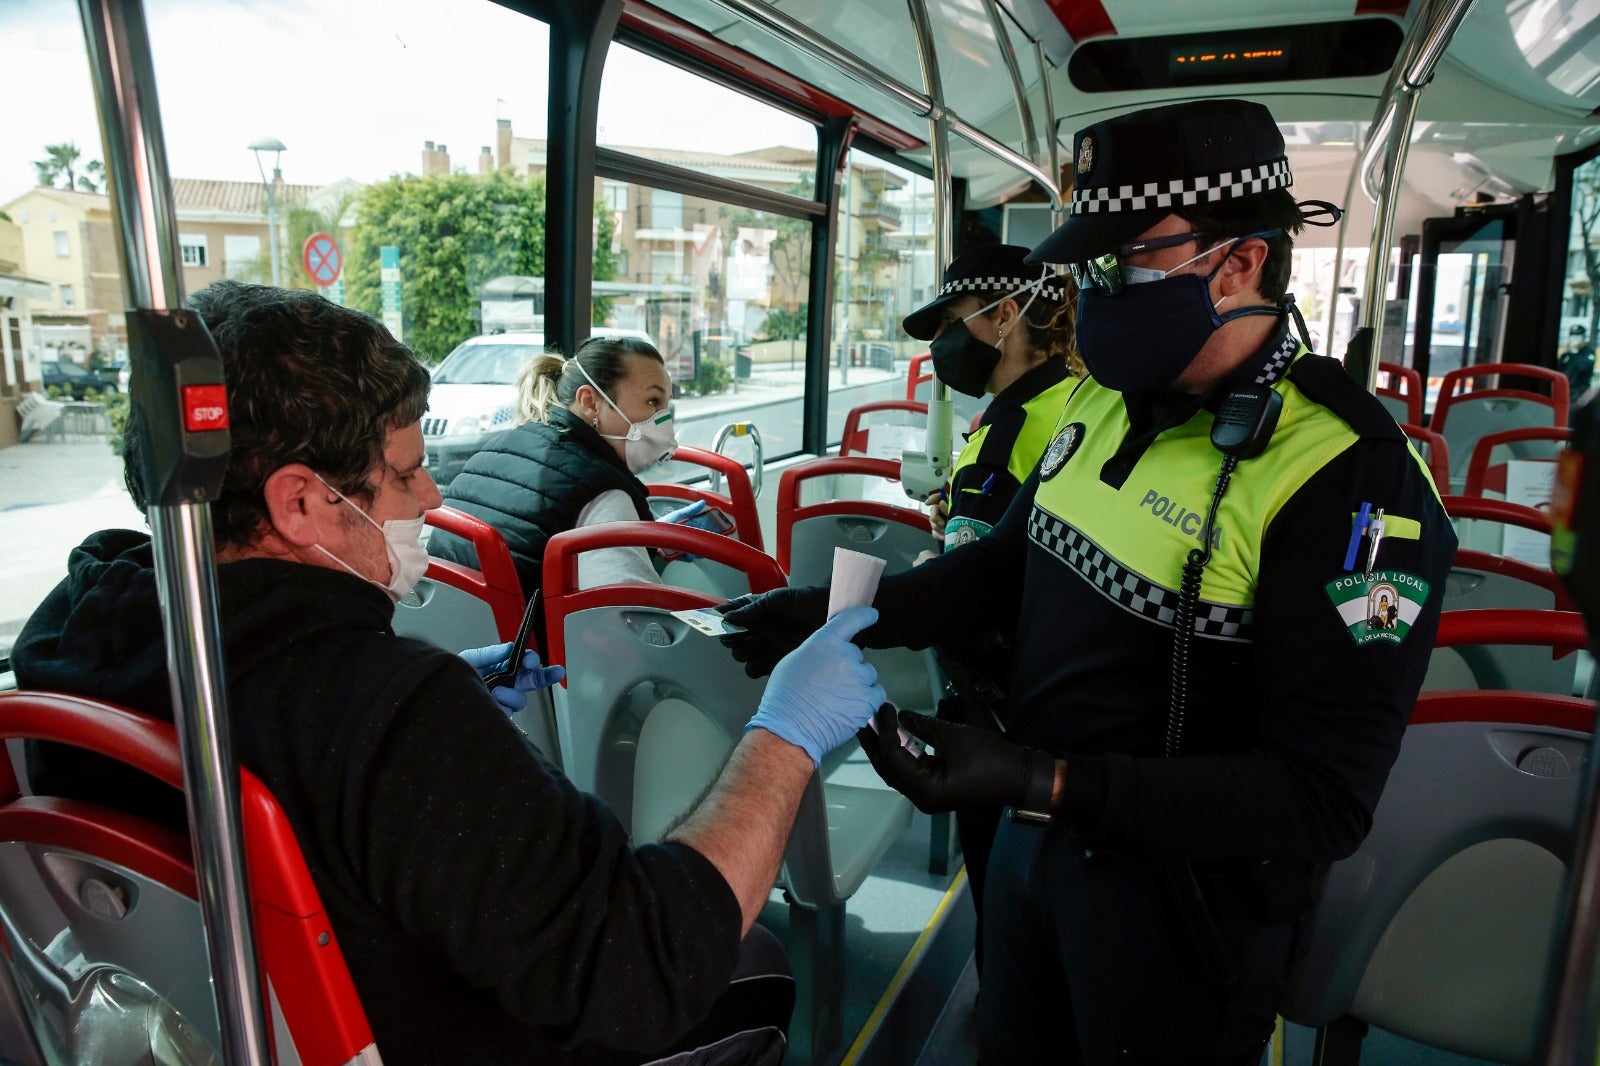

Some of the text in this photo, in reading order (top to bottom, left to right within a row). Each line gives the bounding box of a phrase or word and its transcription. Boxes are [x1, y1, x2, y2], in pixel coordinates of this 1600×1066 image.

[194, 406, 224, 421] STOP
[1139, 489, 1222, 550] POLICIA
[1335, 572, 1423, 592] POLICIA LOCAL
